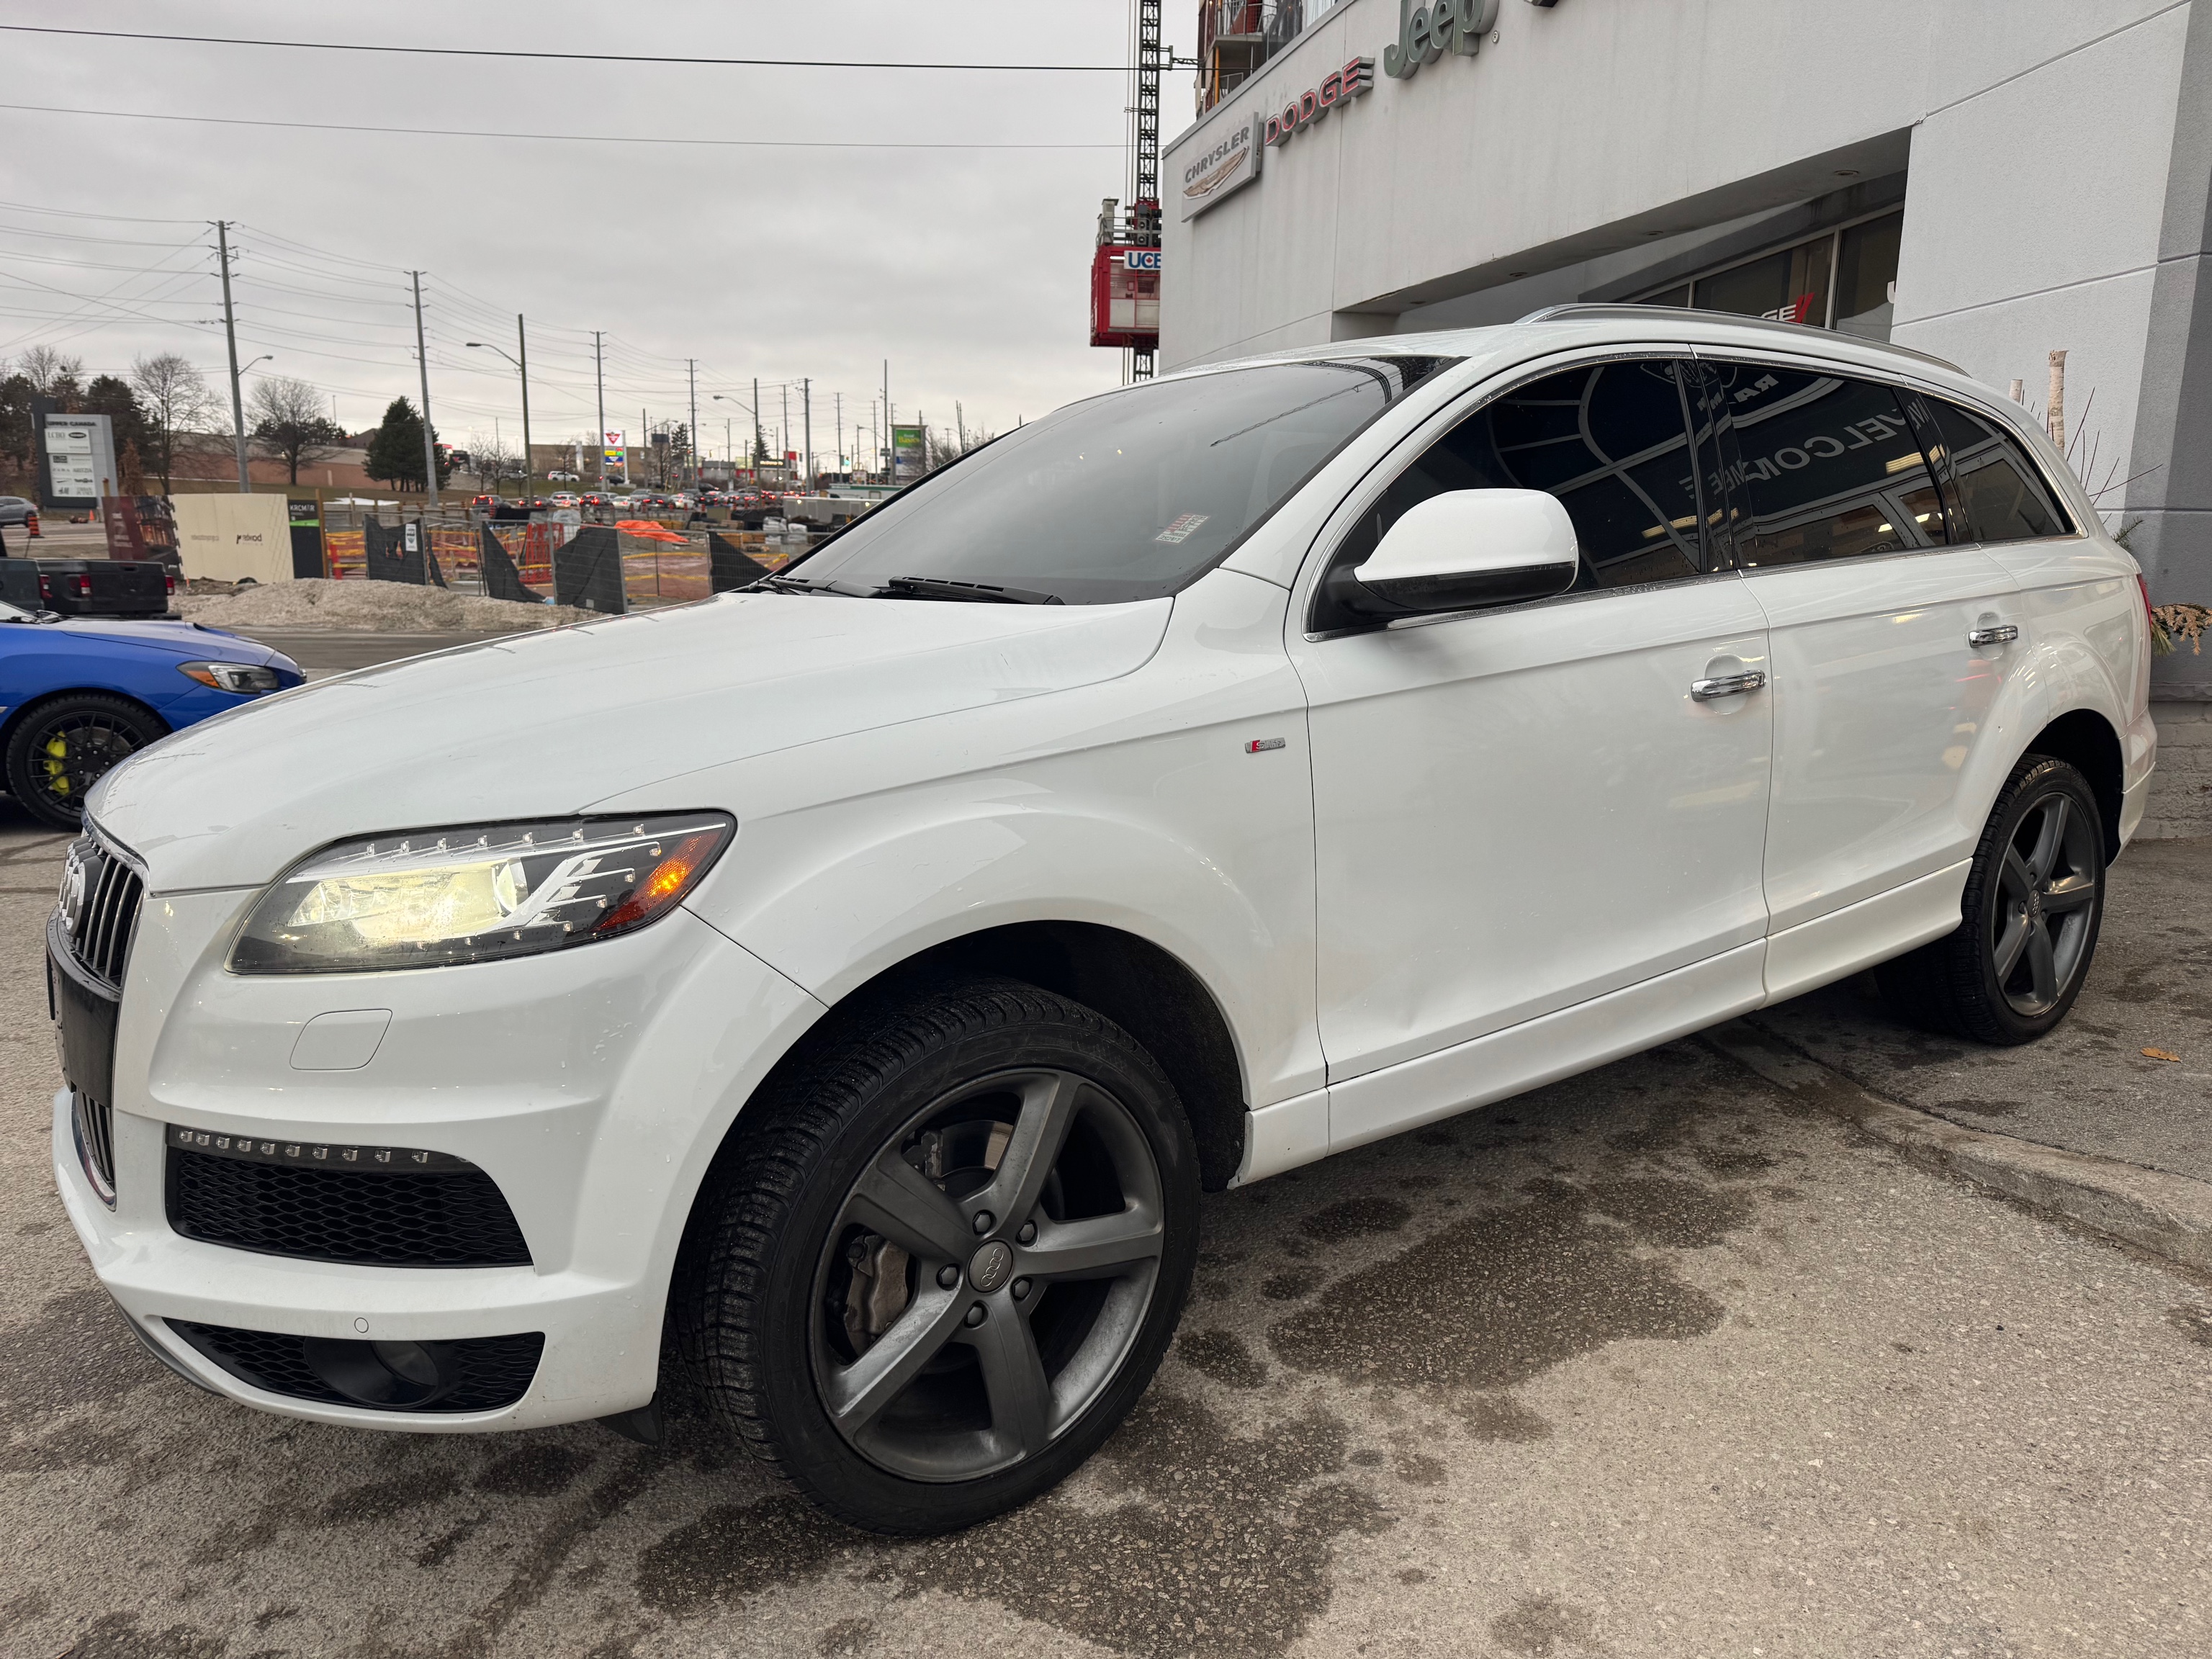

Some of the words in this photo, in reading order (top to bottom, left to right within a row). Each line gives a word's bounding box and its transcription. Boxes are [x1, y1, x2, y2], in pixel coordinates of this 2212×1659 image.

[1384, 0, 1492, 79] Jeep
[1265, 56, 1370, 147] DODGE
[1183, 125, 1250, 185] CHRYSLER
[1265, 739, 1282, 749] line
